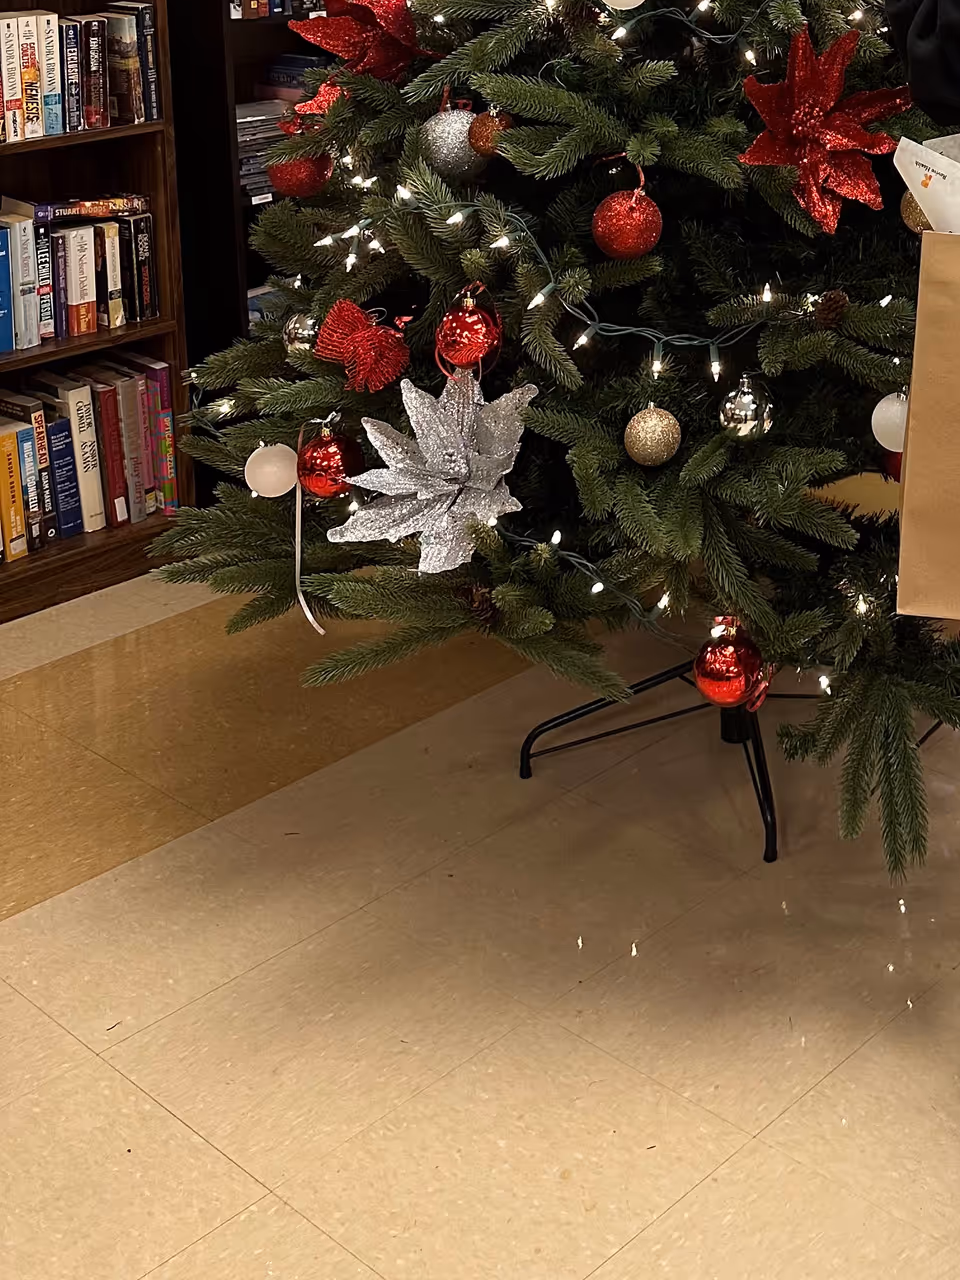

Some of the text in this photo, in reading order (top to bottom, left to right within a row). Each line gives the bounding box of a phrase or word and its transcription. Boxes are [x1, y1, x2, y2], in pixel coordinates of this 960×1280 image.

[4, 32, 17, 98] SANDRA BROWN
[21, 42, 29, 70] COULTER
[44, 28, 56, 92] SANDRA BROWN
[67, 48, 78, 83] EXCLUSIVE
[24, 81, 39, 122] NEMESIS
[55, 208, 80, 216] STUART
[80, 205, 107, 214] WOODS
[38, 248, 50, 286] LEE CHILD
[78, 253, 88, 300] Nelson DeMille
[76, 400, 86, 434] CALDWELL
[84, 402, 92, 429] TAYLOR
[34, 414, 48, 465] SPEARHEAD
[89, 441, 97, 470] ANSWER
[164, 416, 174, 478] OPTICAL PUZZLES
[24, 442, 39, 512] MICHAEL CONNELLY
[41, 472, 52, 512] ADAM MAKOS
[130, 456, 144, 505] play dirty
